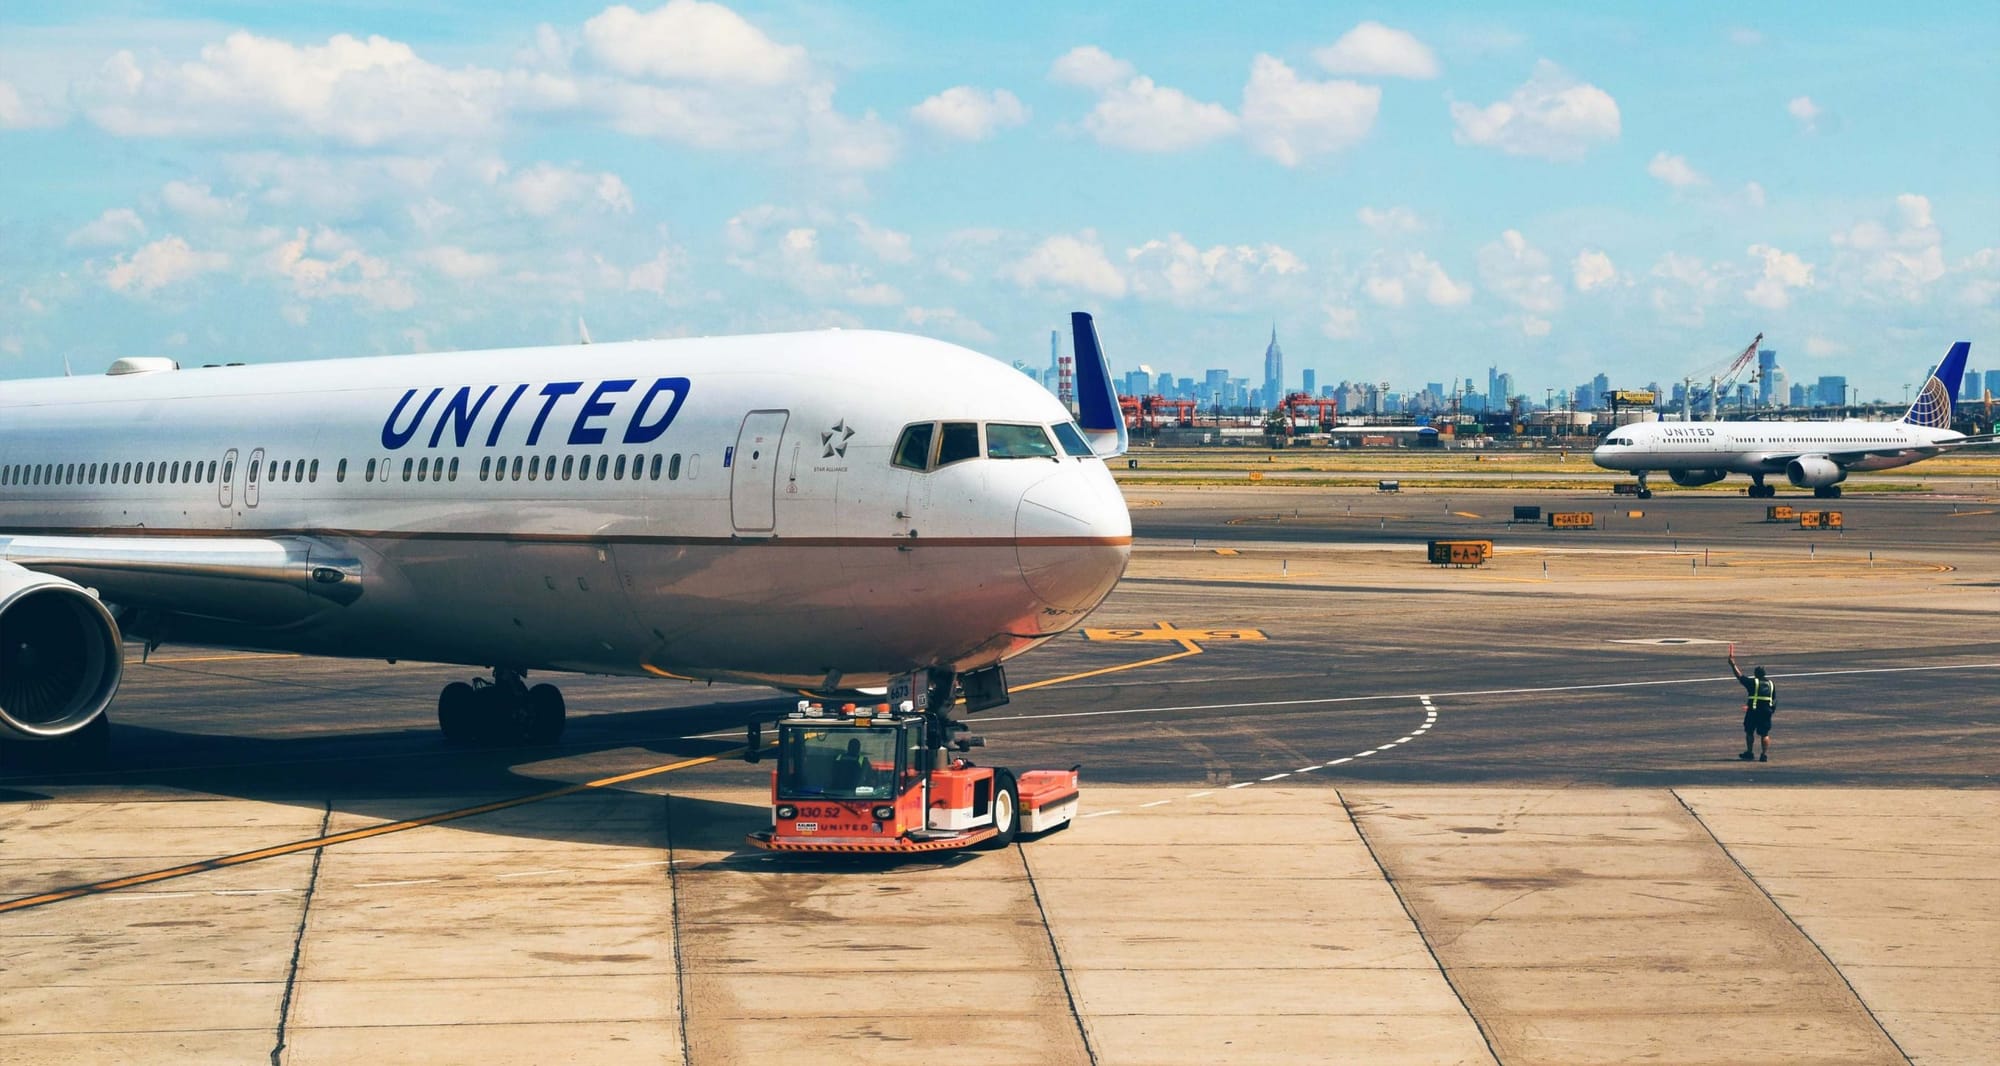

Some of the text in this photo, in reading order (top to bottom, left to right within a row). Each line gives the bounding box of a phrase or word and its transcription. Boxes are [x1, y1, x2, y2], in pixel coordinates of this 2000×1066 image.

[381, 377, 691, 450] UNITED
[1664, 428, 1715, 437] UNITED
[1561, 514, 1579, 524] GATE
[1462, 547, 1470, 561] A
[820, 823, 869, 832] UNITED
